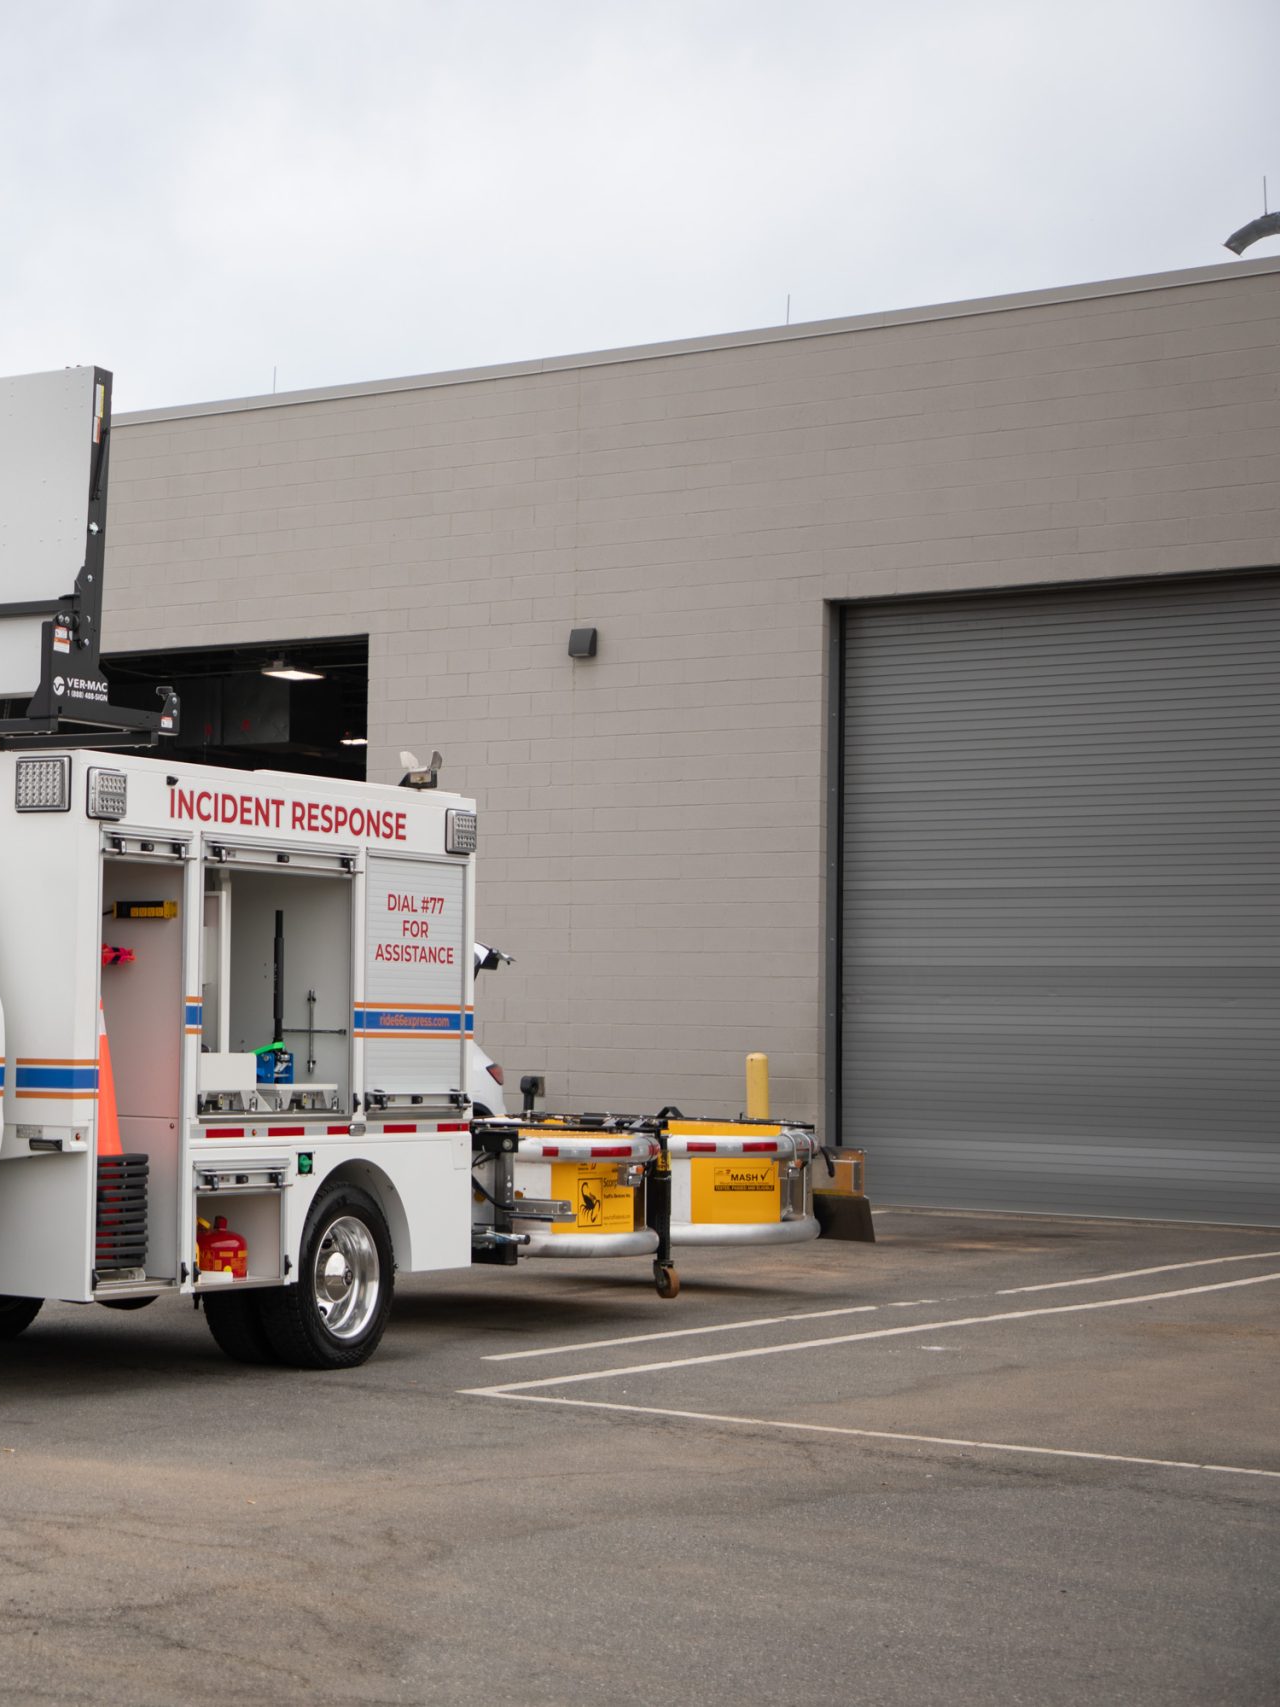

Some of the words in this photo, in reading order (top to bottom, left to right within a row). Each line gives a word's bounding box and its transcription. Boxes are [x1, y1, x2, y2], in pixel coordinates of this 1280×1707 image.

[67, 677, 108, 692] VER-MAC
[169, 788, 284, 828] INCIDENT
[291, 801, 407, 840] RESPONSE
[387, 894, 418, 912] DIAL
[421, 896, 445, 914] #77
[402, 920, 429, 938] FOR
[375, 944, 454, 964] ASSISTANCE
[730, 1173, 758, 1181] MASH
